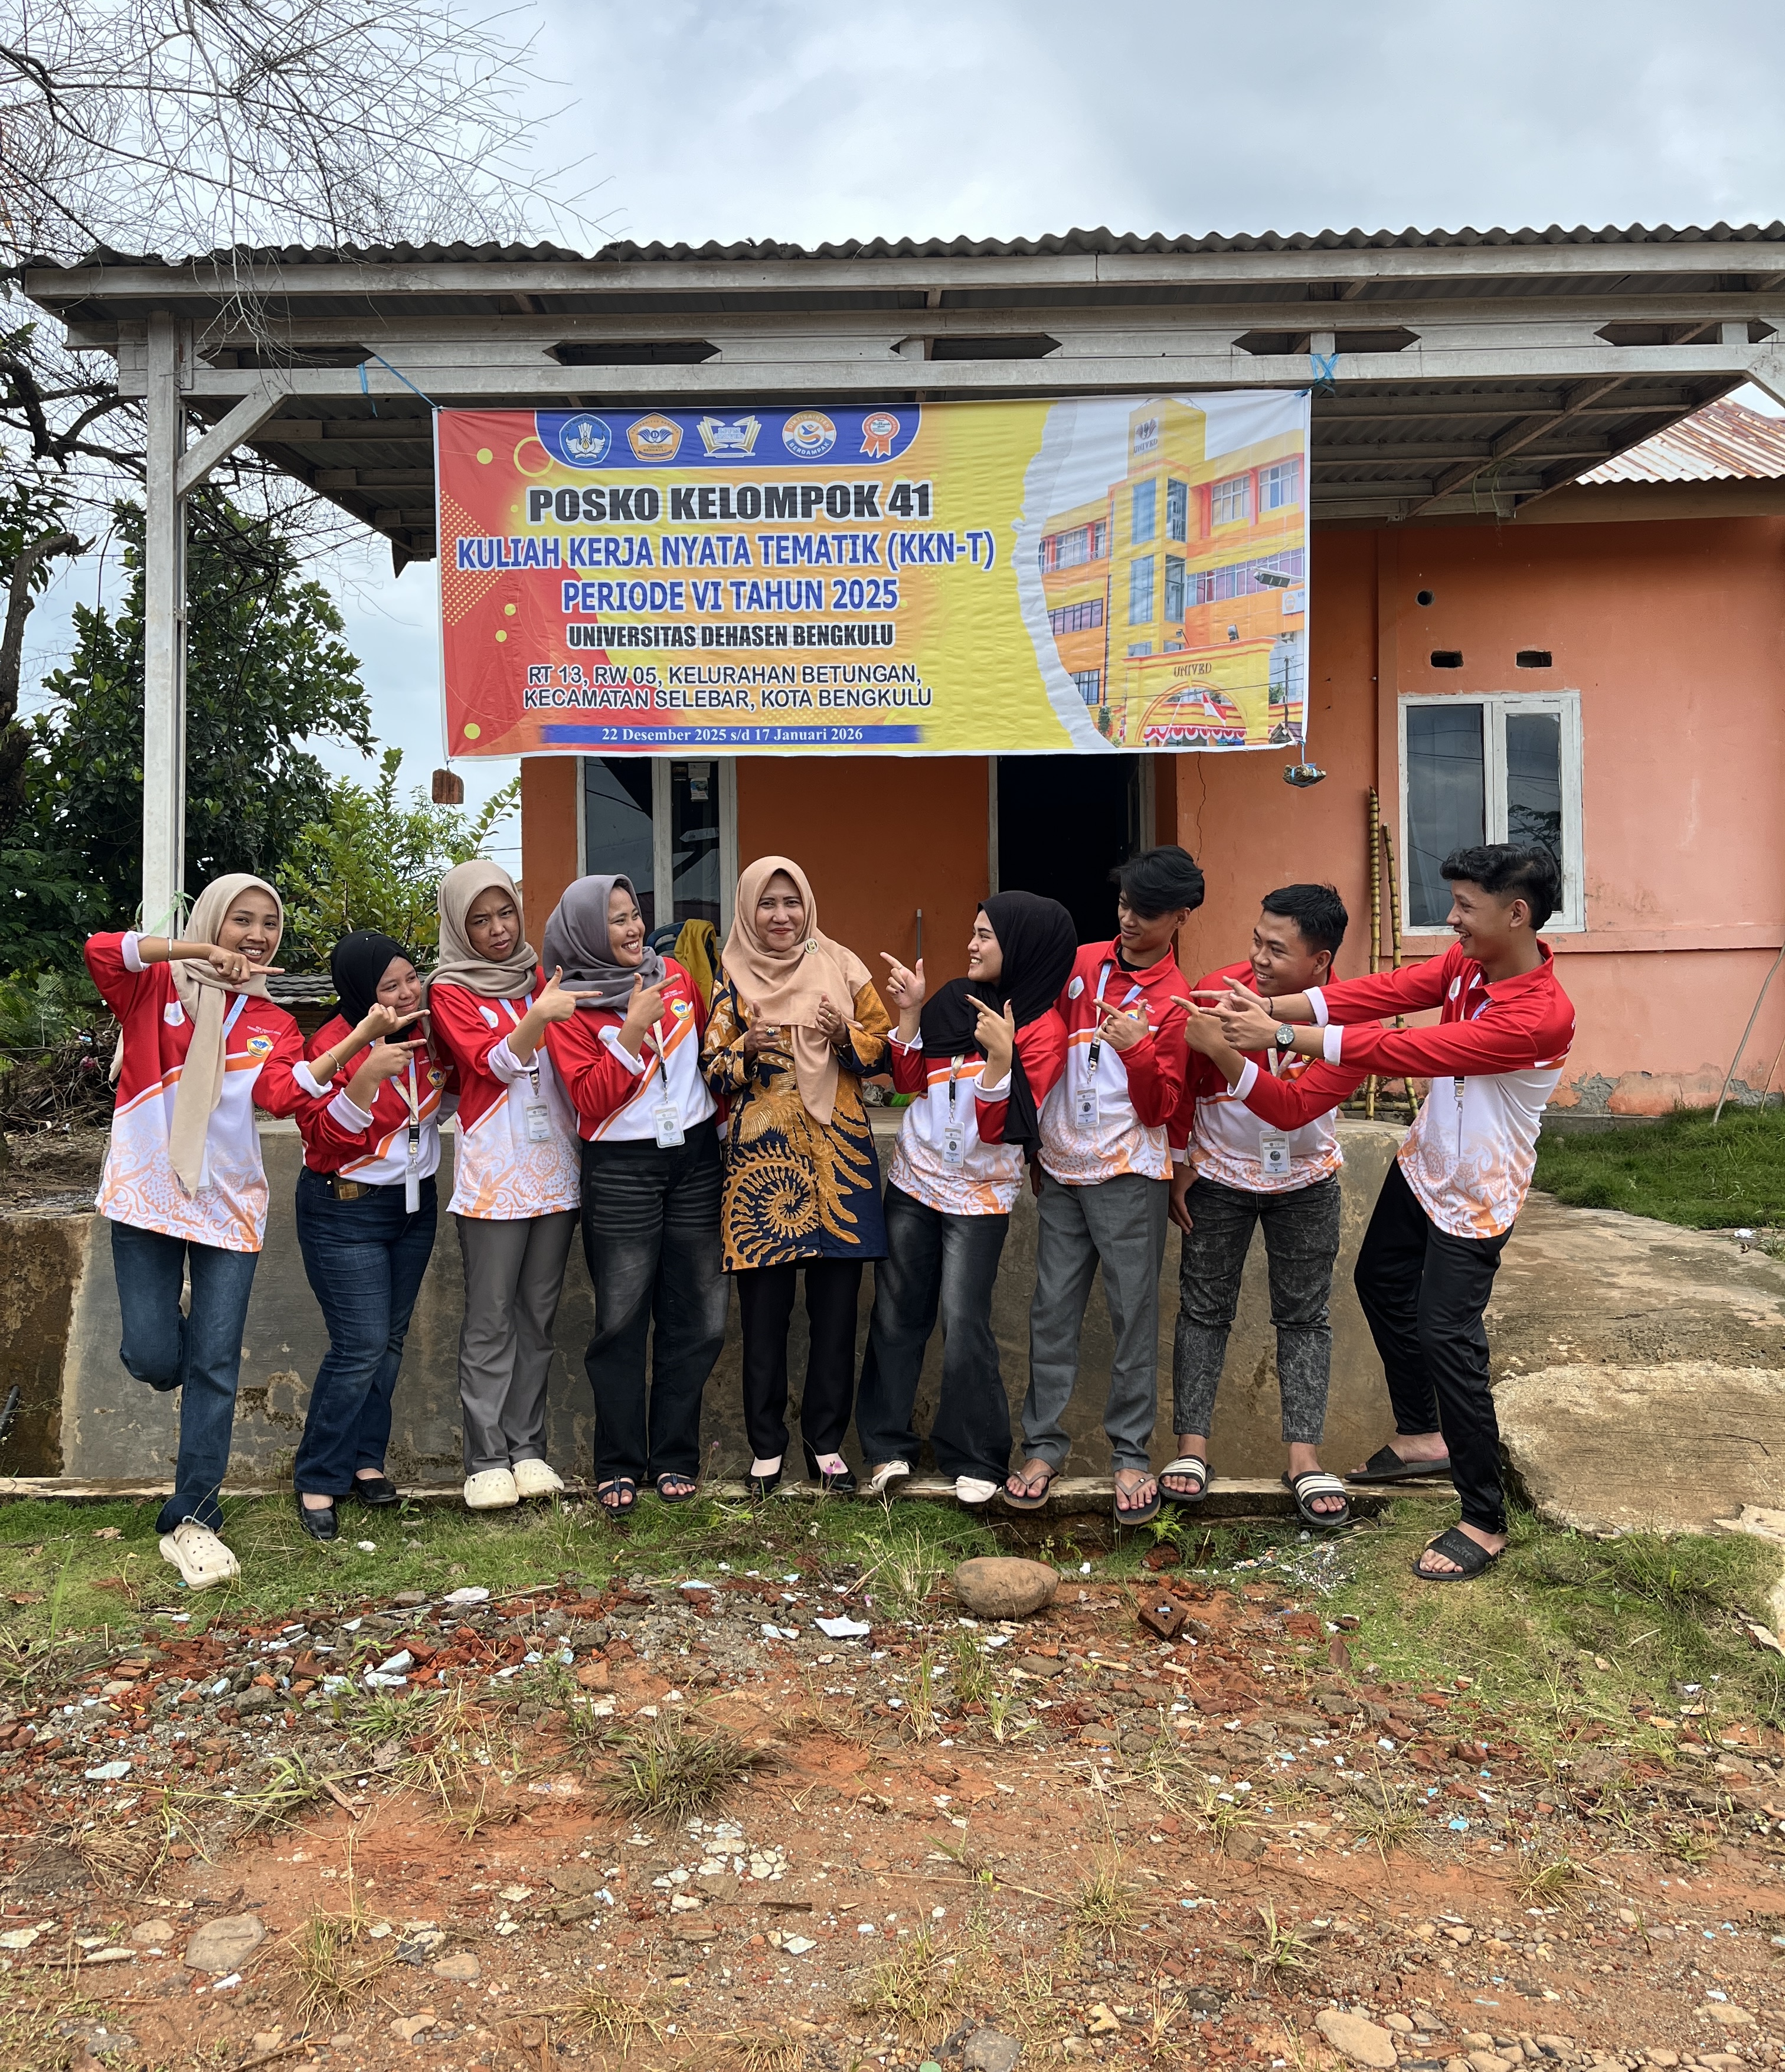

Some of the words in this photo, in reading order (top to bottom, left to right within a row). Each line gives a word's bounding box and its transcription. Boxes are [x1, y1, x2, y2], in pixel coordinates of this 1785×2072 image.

[787, 414, 831, 429] DIKTISAINTEK
[789, 442, 830, 455] BERDAMPAK
[529, 488, 659, 522] POSKO
[671, 484, 881, 520] KELOMPOK
[888, 483, 930, 517] 41
[458, 537, 560, 568] KULIAH
[570, 536, 653, 567] KERJA
[662, 535, 751, 566] NYATA
[758, 533, 880, 565] TEMATIK
[887, 531, 994, 571] (KKN-T)
[564, 580, 684, 612] PERIODE
[691, 581, 721, 610] VI
[730, 580, 823, 610] TAHUN
[832, 578, 898, 610] 2025
[568, 625, 696, 648] UNIVERSITAS
[701, 623, 788, 647] DEHASEN
[793, 623, 894, 646] BENGKULU
[529, 666, 553, 684] RT
[558, 665, 588, 687] 13,
[595, 666, 627, 684] RW
[633, 666, 662, 688] 05,
[669, 665, 796, 684] KELURAHAN
[802, 664, 921, 687] BETUNGAN,
[1173, 662, 1212, 677] UNIVED
[524, 689, 649, 708] KECAMATAN
[655, 688, 756, 711] SELEBAR,
[761, 689, 813, 708] KOTA
[818, 688, 931, 707] BENGKULU
[601, 728, 618, 741] 22
[622, 728, 691, 741] Desember
[694, 728, 727, 741] 2025
[730, 728, 750, 741] s/d
[754, 728, 770, 741] 17
[773, 727, 828, 741] Januari
[830, 727, 863, 741] 2026
